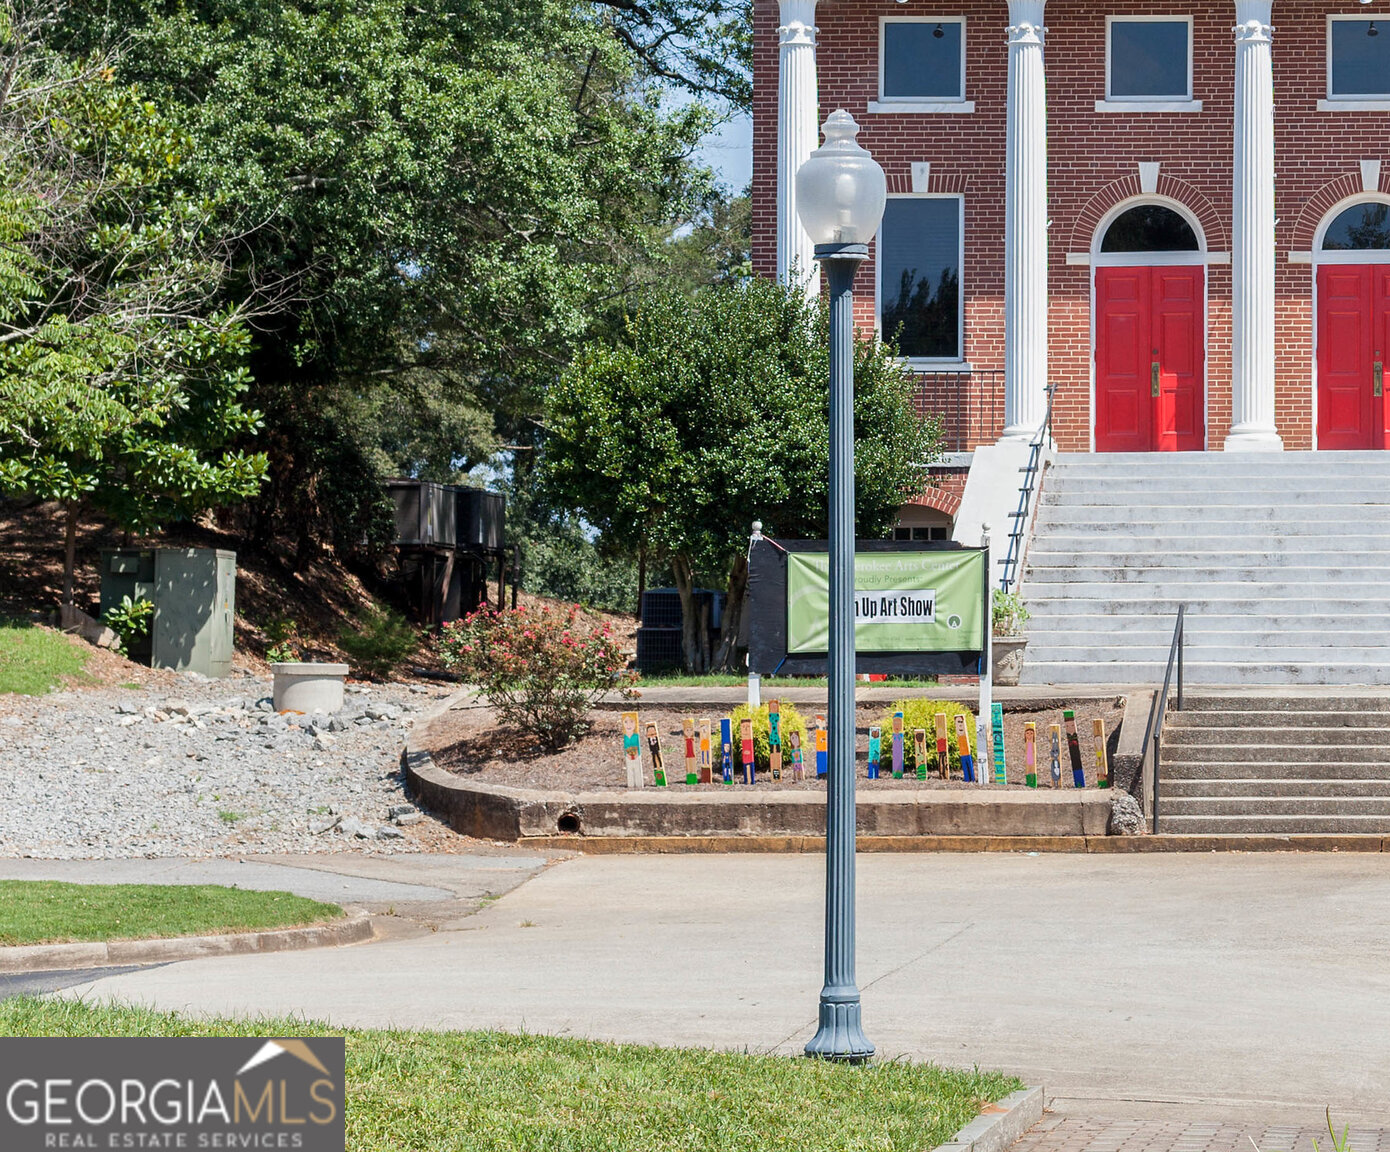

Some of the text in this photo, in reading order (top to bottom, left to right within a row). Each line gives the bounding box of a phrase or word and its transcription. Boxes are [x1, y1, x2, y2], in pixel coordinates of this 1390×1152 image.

[896, 559, 918, 571] Arts
[921, 558, 961, 570] Center
[854, 574, 882, 585] roudly
[862, 597, 877, 618] Up
[880, 597, 898, 616] Art
[900, 596, 933, 616] Show
